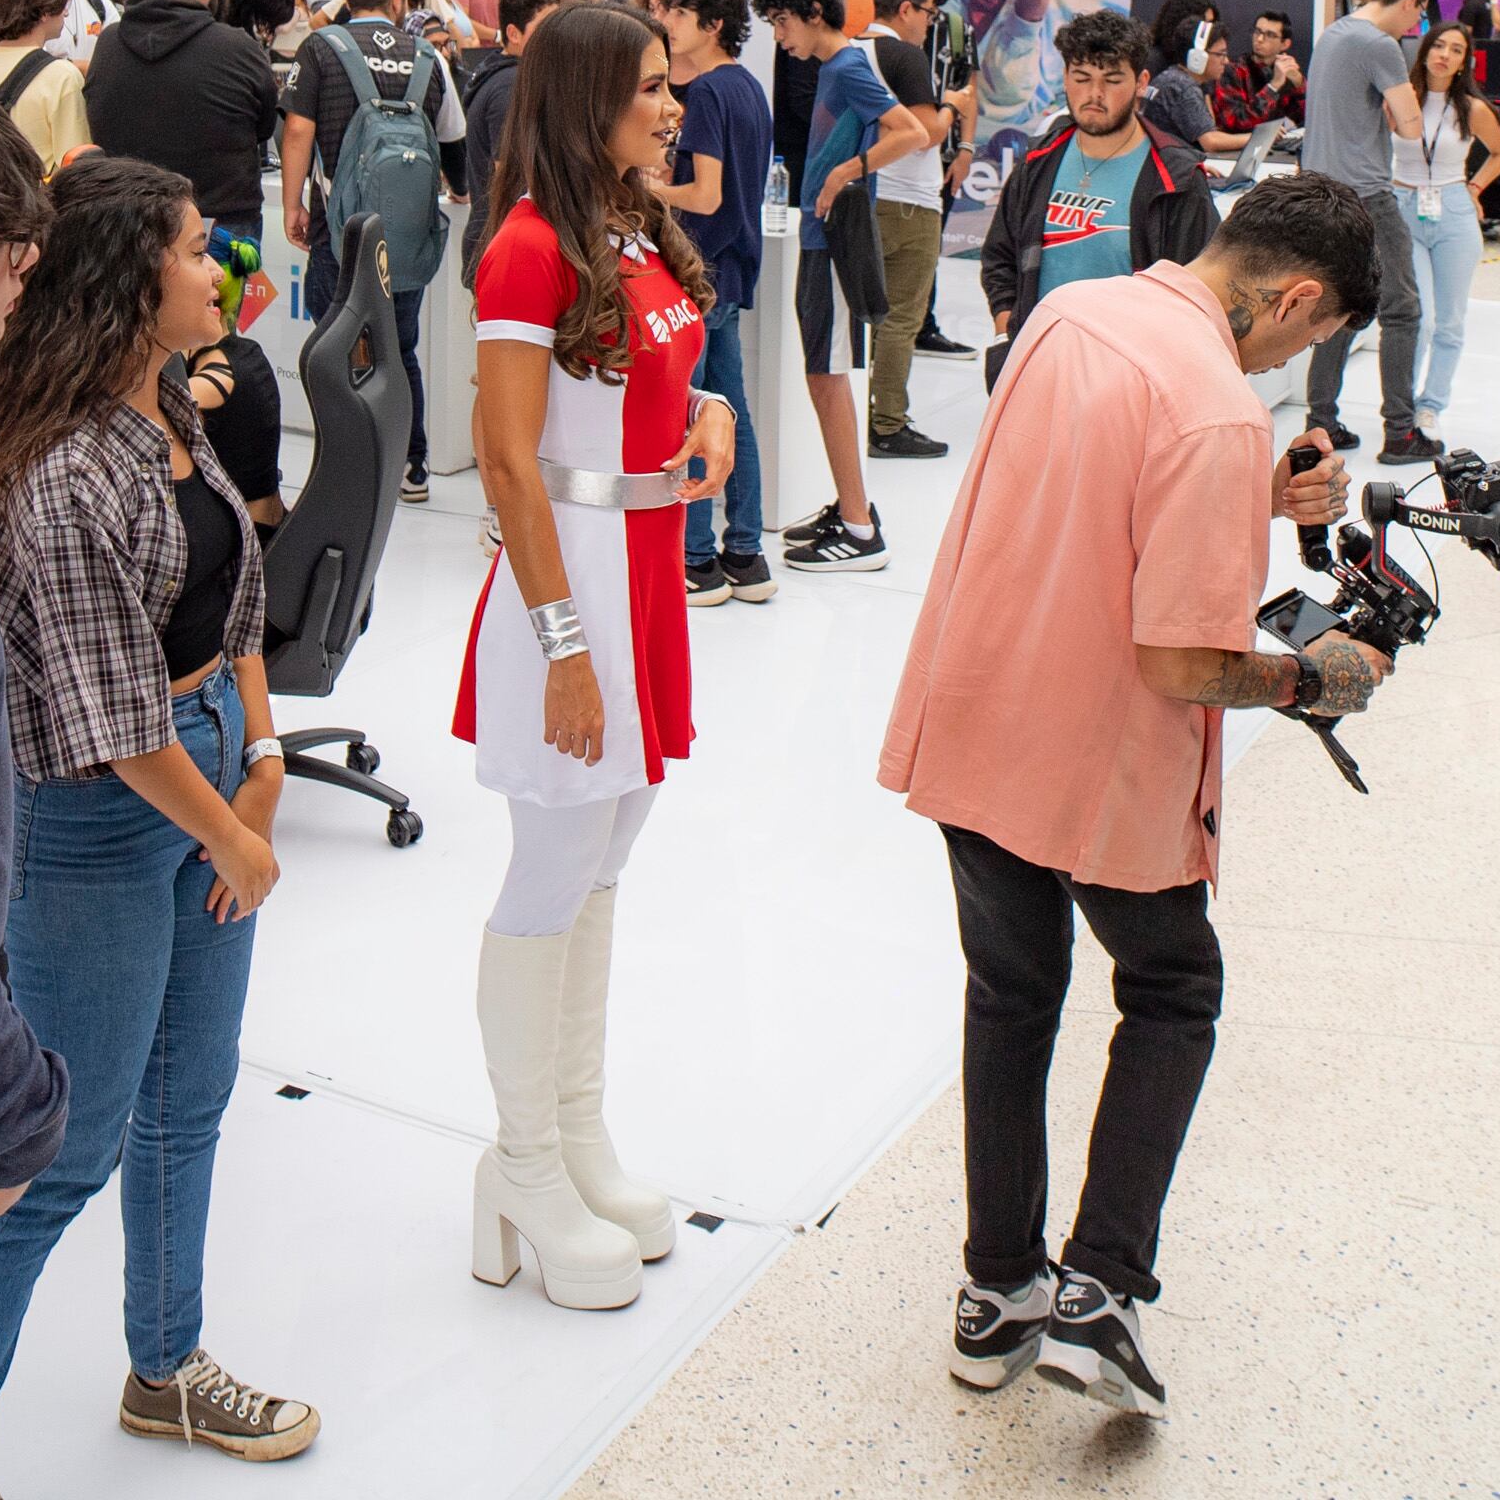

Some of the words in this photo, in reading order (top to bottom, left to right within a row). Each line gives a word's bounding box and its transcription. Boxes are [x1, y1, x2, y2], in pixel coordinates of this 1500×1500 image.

[245, 284, 266, 297] EN
[664, 298, 699, 332] BAC
[1408, 510, 1460, 532] RONIN
